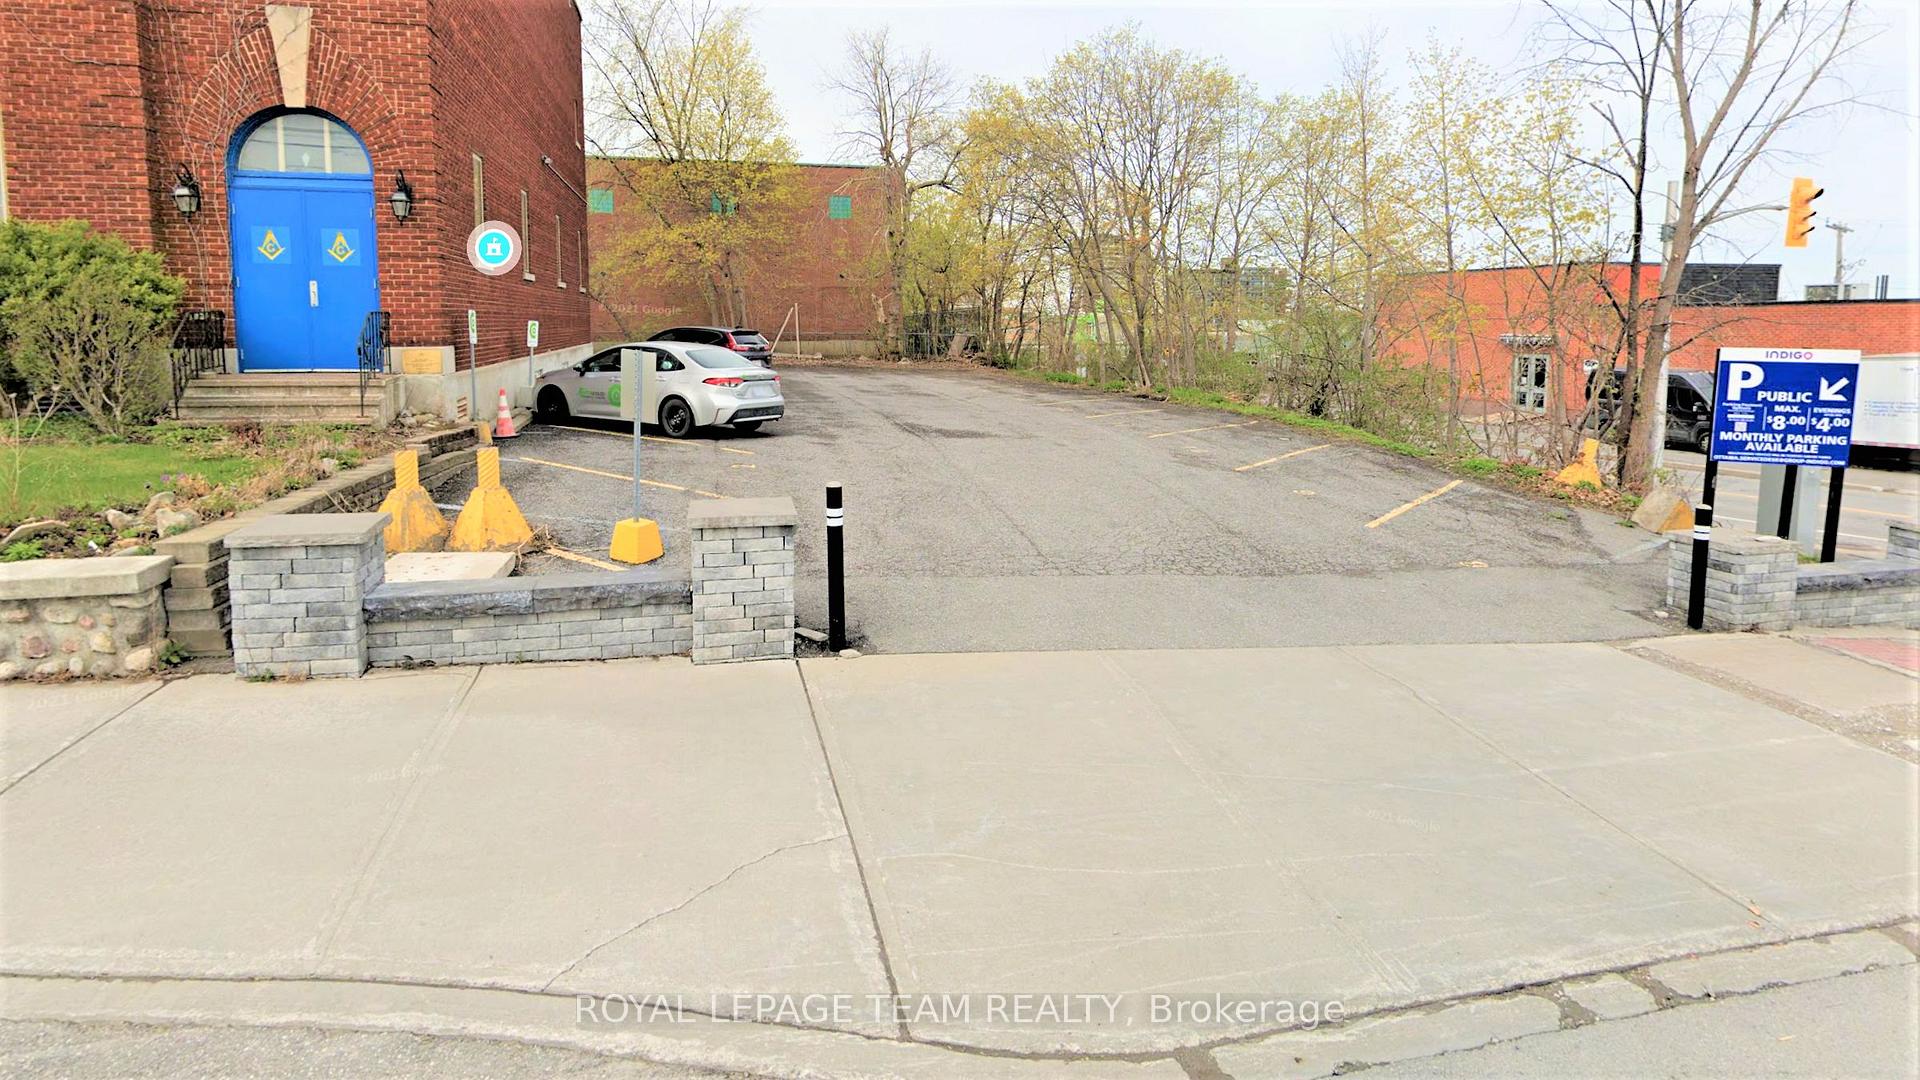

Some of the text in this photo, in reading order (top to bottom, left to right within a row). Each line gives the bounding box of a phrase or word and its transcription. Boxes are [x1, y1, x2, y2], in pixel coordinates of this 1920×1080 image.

[1765, 350, 1813, 360] INDIGO
[1727, 363, 1765, 401] P
[1757, 390, 1813, 403] PUBLIC
[1774, 404, 1802, 413] MAX.
[1813, 407, 1852, 415] EVENINGS
[1766, 415, 1807, 431] $8.00
[1810, 417, 1850, 432] $4.00
[1720, 431, 1848, 446] MONTHLY PARKING
[1744, 442, 1819, 454] AVAILABLE
